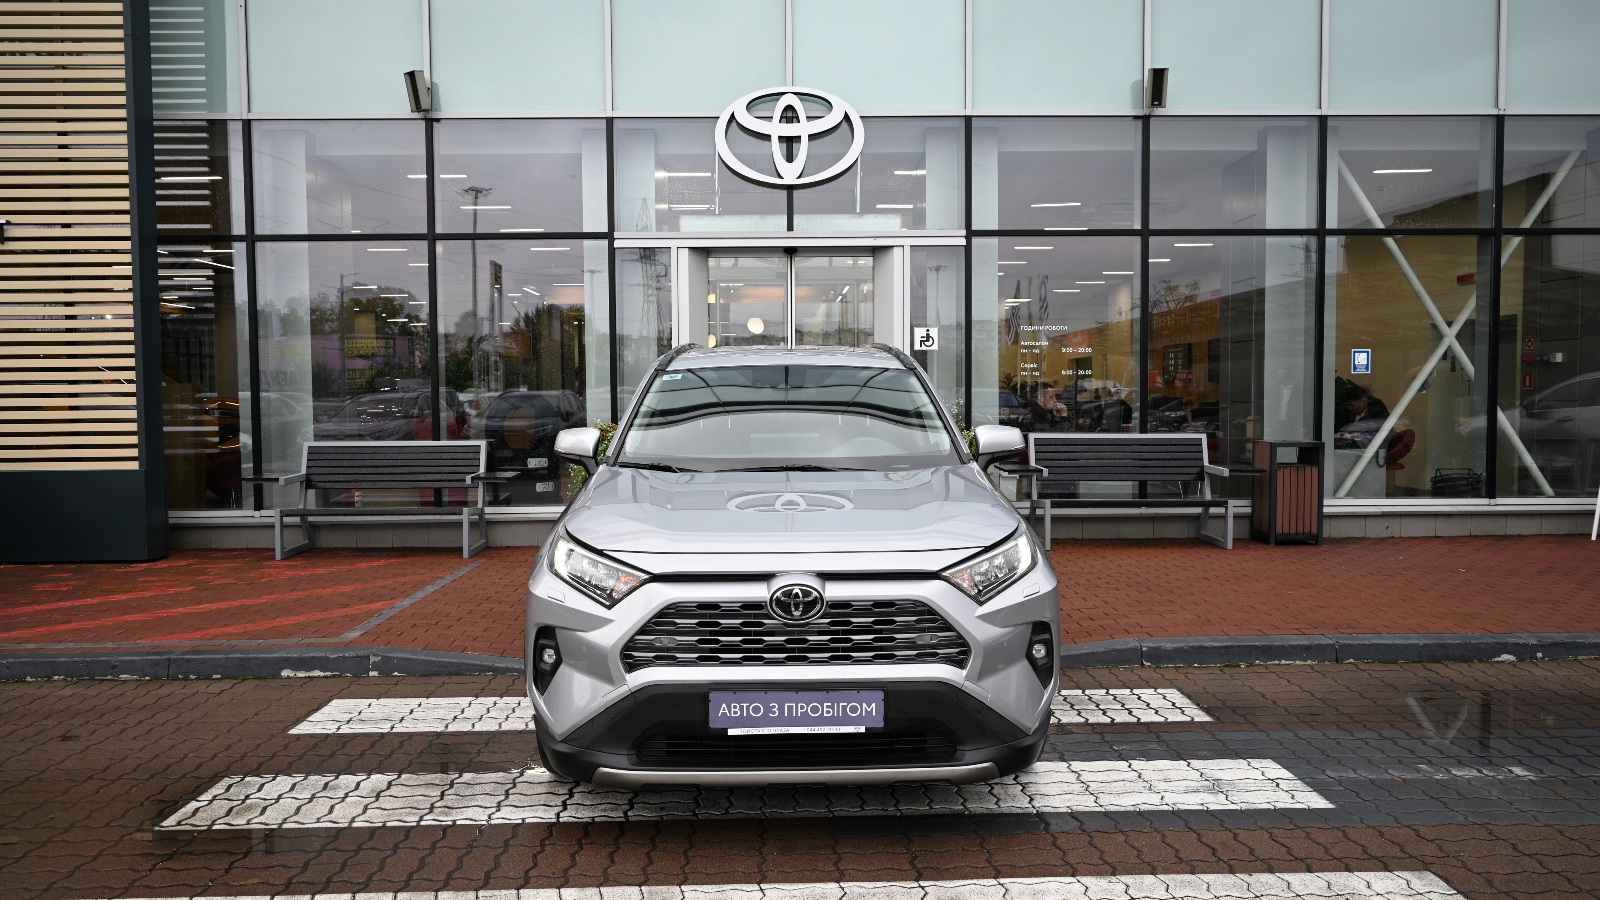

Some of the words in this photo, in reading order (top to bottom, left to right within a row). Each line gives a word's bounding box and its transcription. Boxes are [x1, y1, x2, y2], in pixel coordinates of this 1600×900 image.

[718, 702, 764, 717] АВТО
[768, 702, 779, 717] З
[784, 702, 876, 717] ПРОБІГОМ
